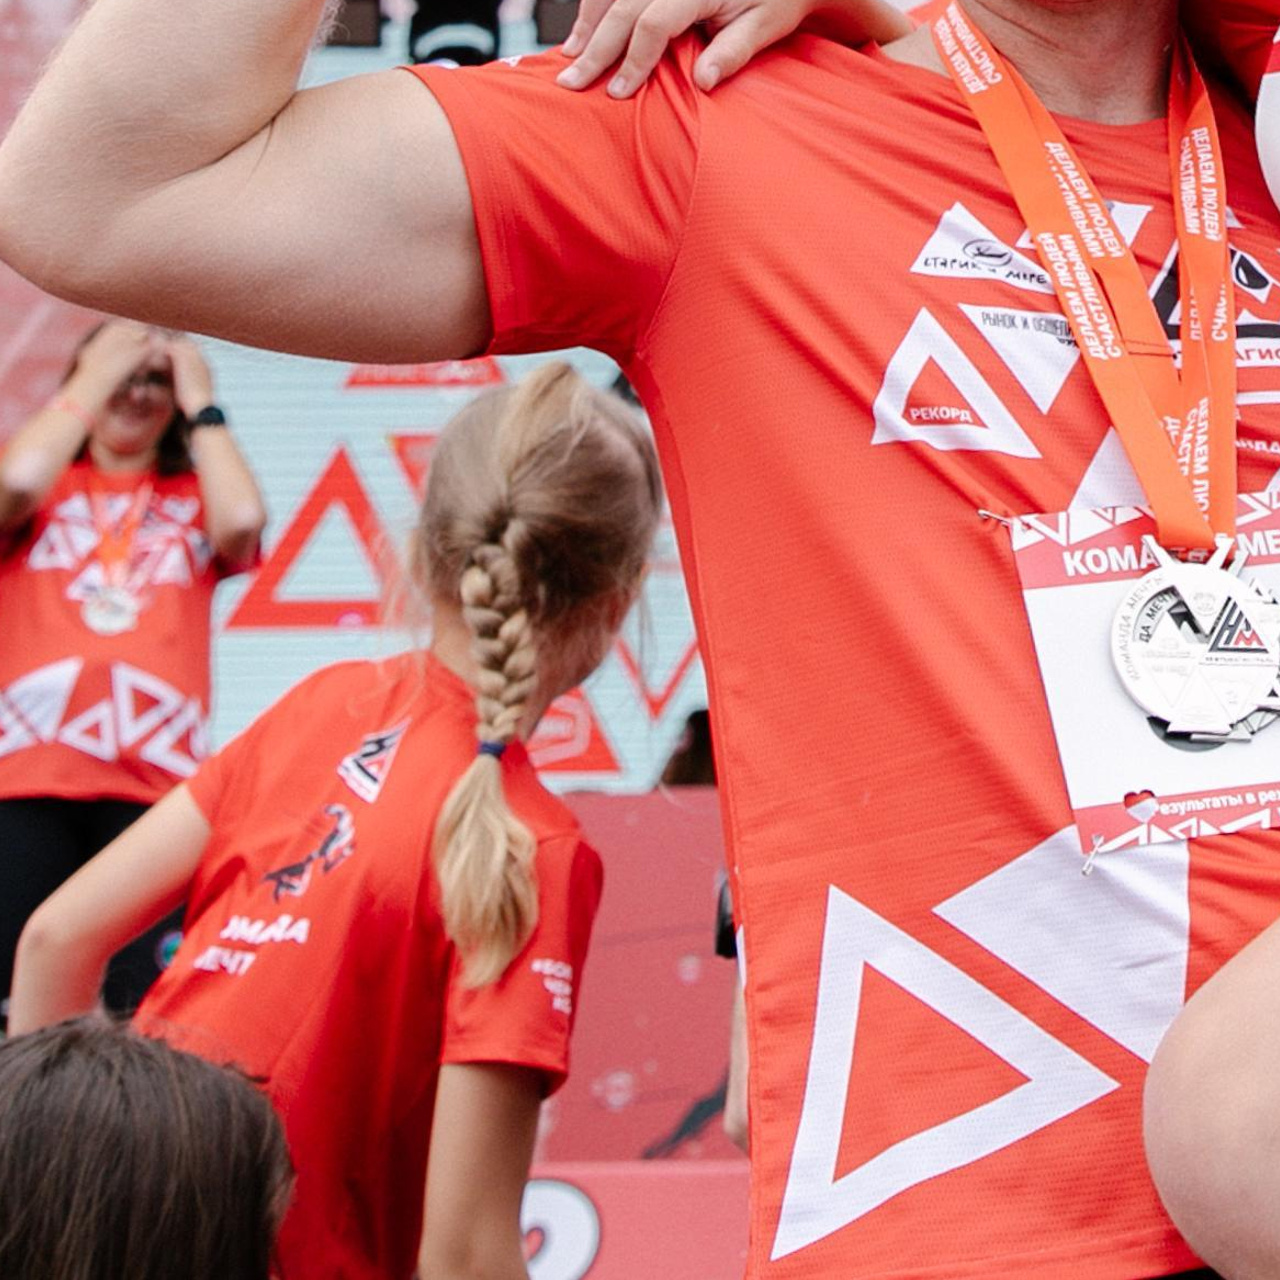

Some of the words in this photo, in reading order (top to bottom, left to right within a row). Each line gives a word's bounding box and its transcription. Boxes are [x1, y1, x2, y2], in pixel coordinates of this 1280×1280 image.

[1045, 141, 1093, 200] ДЕЛАЕМ
[1191, 126, 1217, 184] ДЕЛАЕМ
[1058, 233, 1122, 358] СЧАСТЛИВЫМИ
[1064, 290, 1109, 360] ДЕЛАЕМ
